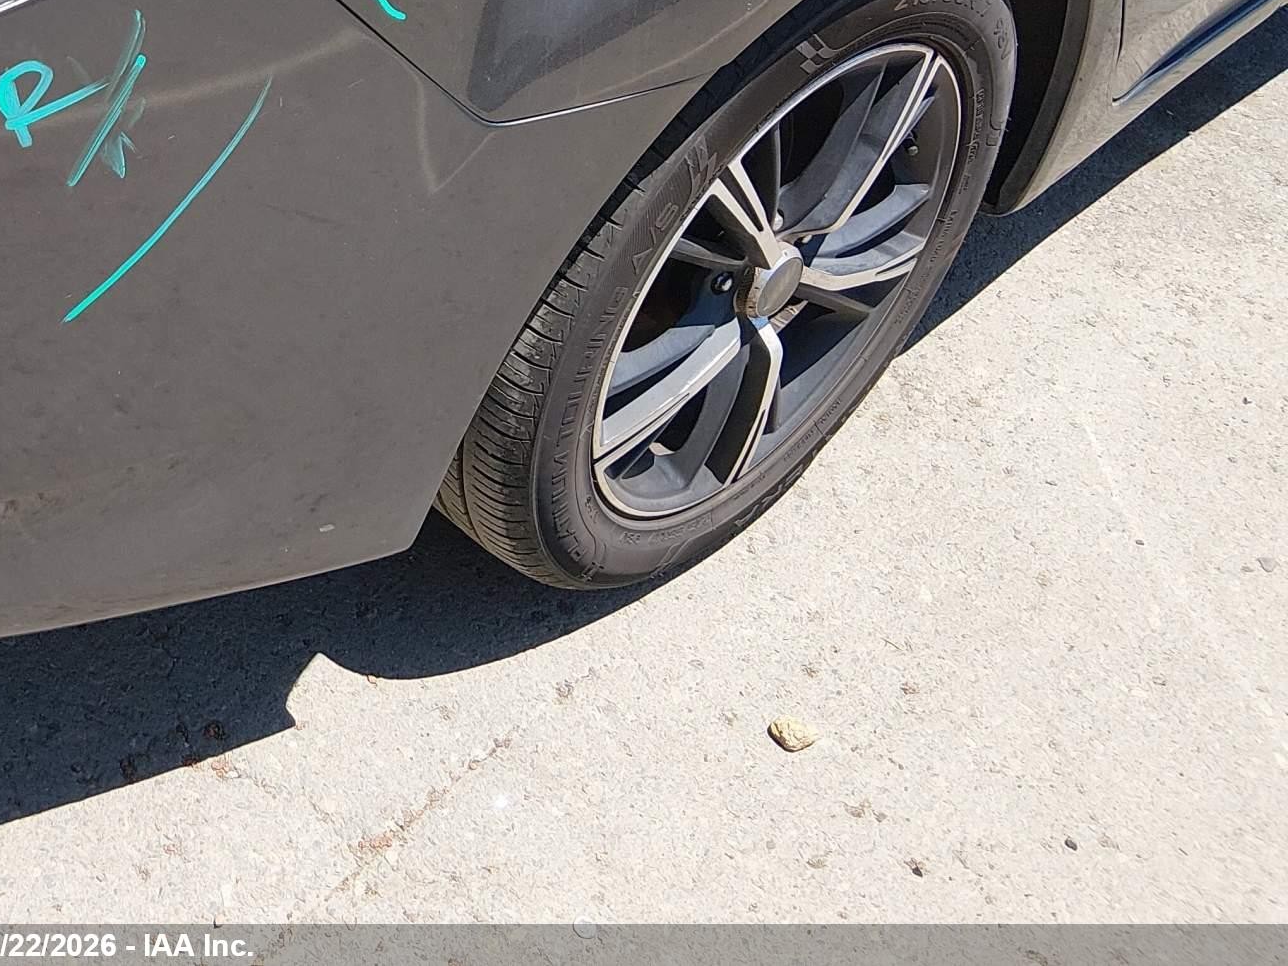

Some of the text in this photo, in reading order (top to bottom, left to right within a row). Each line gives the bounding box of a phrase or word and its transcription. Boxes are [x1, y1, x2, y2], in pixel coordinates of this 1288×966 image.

[632, 203, 679, 275] A/S
[556, 286, 627, 448] TOURING
[553, 453, 586, 564] PLATINUM
